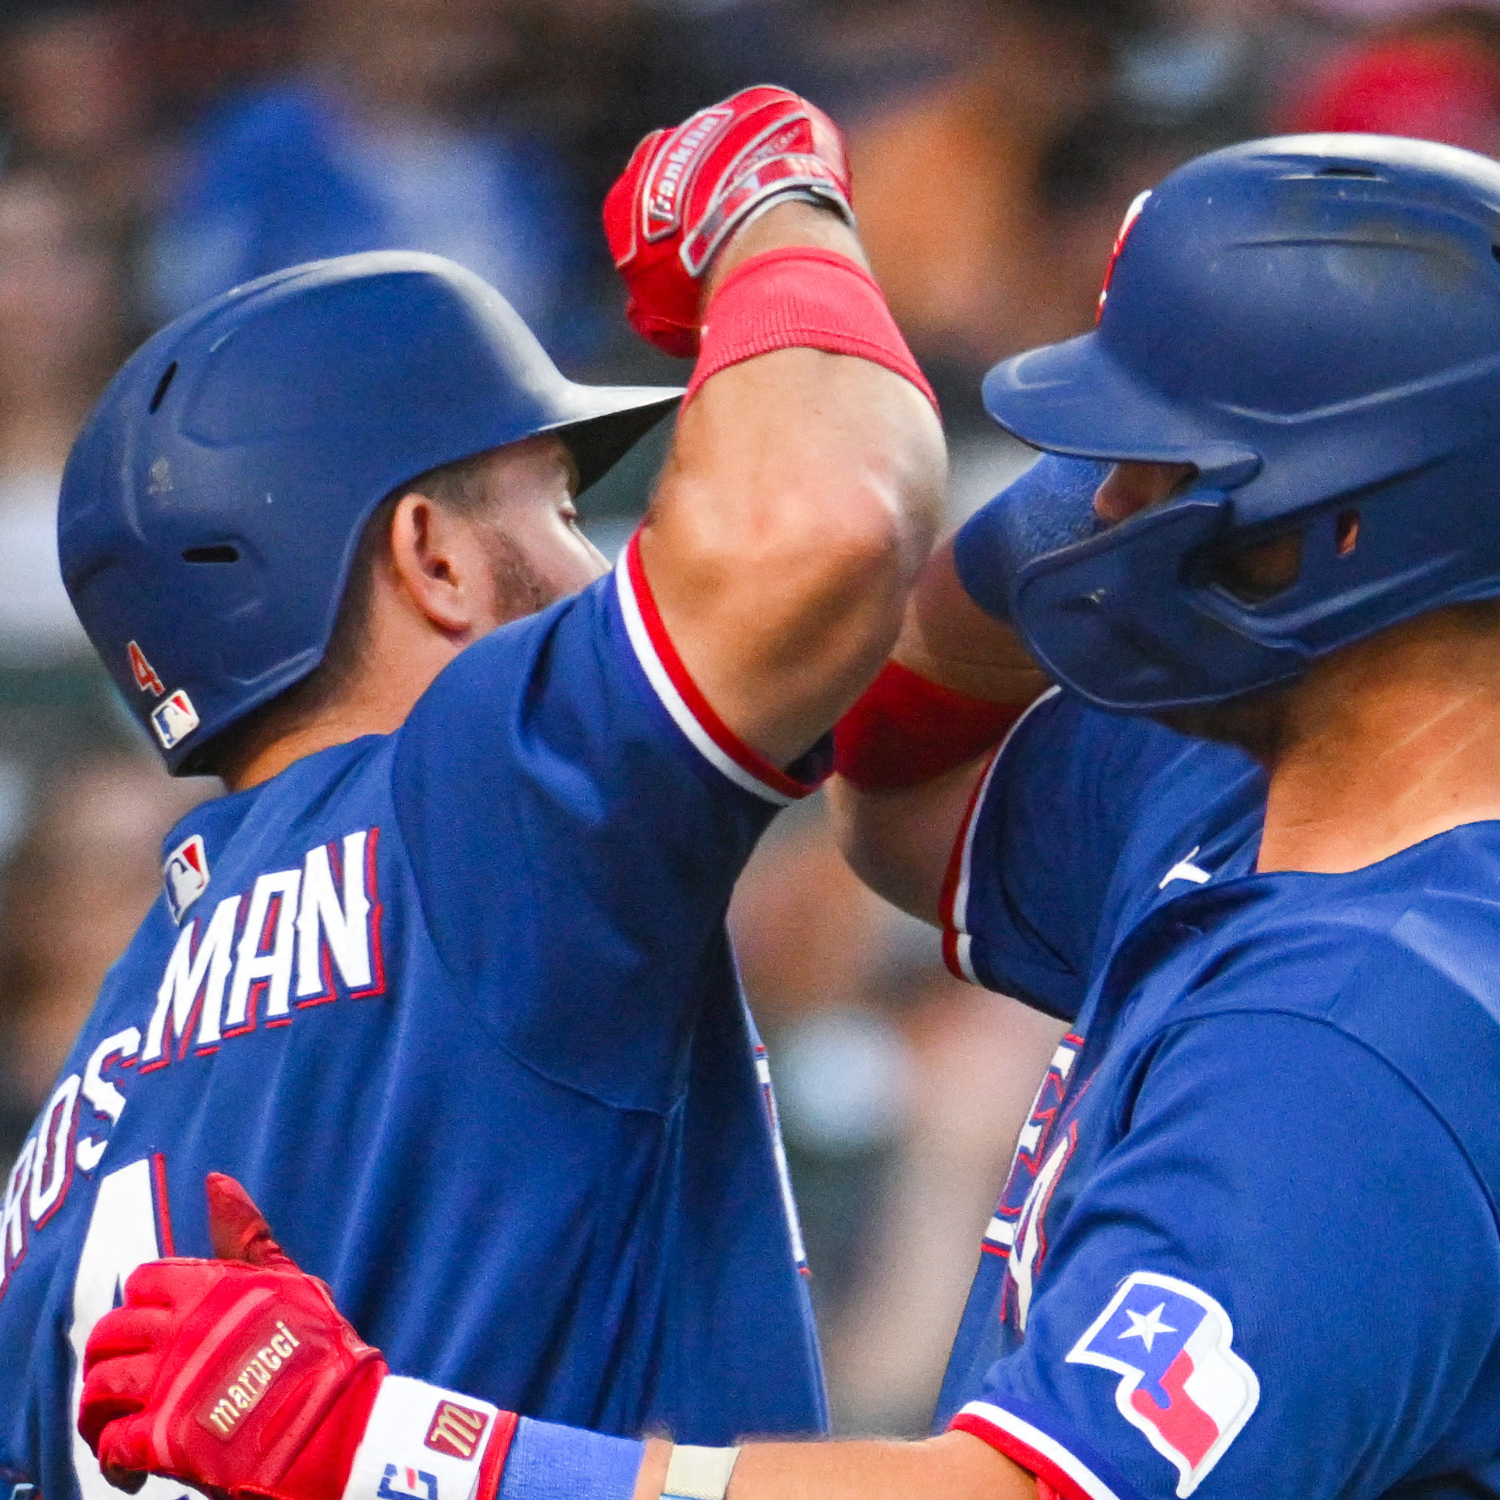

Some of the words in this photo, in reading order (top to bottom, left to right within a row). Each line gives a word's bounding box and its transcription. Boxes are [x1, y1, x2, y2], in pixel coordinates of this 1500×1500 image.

[648, 115, 720, 221] Franklin
[127, 640, 165, 697] 4
[209, 1320, 300, 1432] marucci
